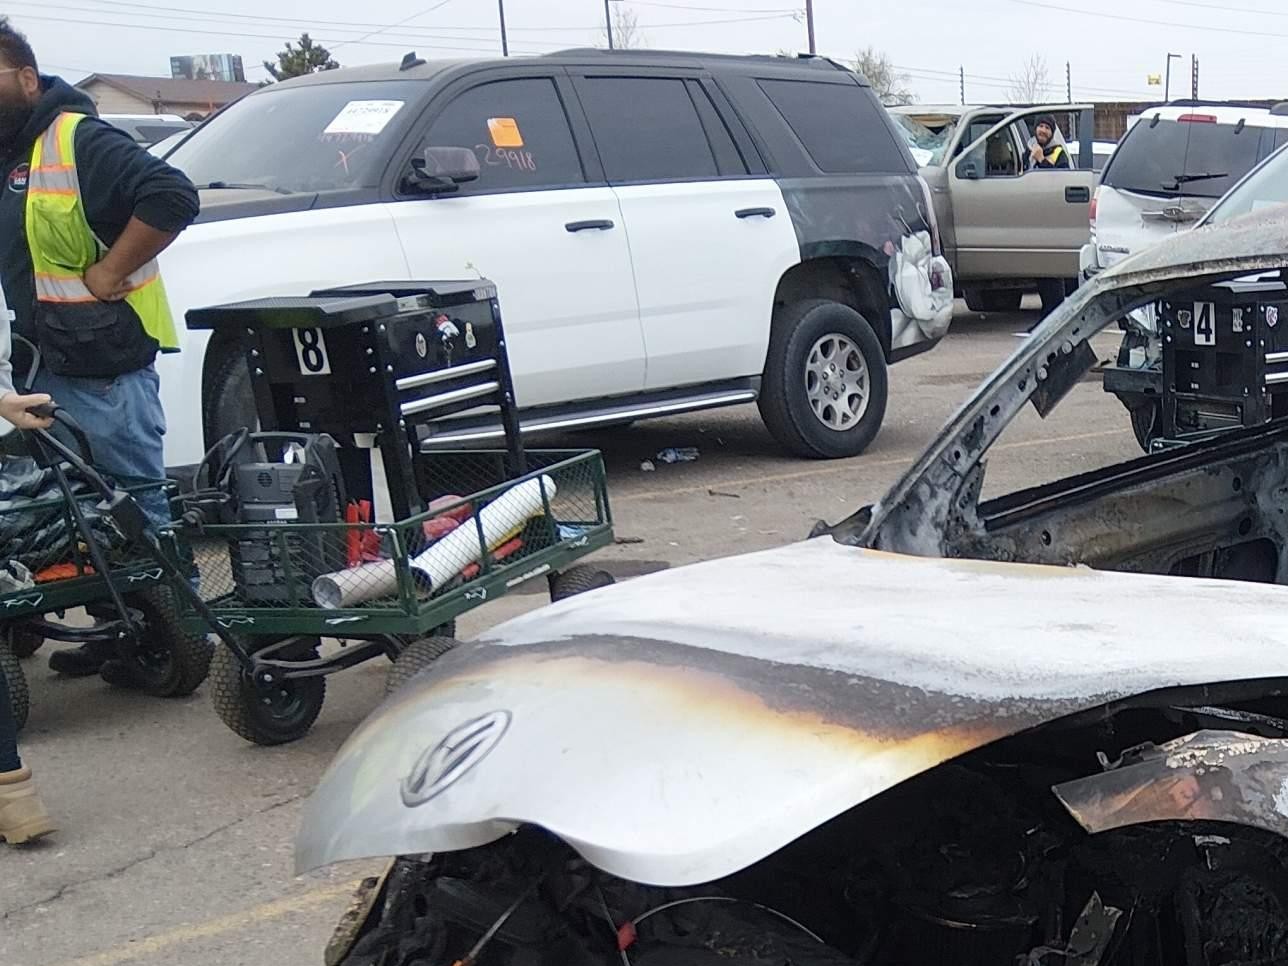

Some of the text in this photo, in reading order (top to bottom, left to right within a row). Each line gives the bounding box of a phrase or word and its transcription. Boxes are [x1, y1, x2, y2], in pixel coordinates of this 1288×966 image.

[475, 144, 537, 172] 29918
[1197, 303, 1213, 343] 4
[299, 327, 325, 372] 8
